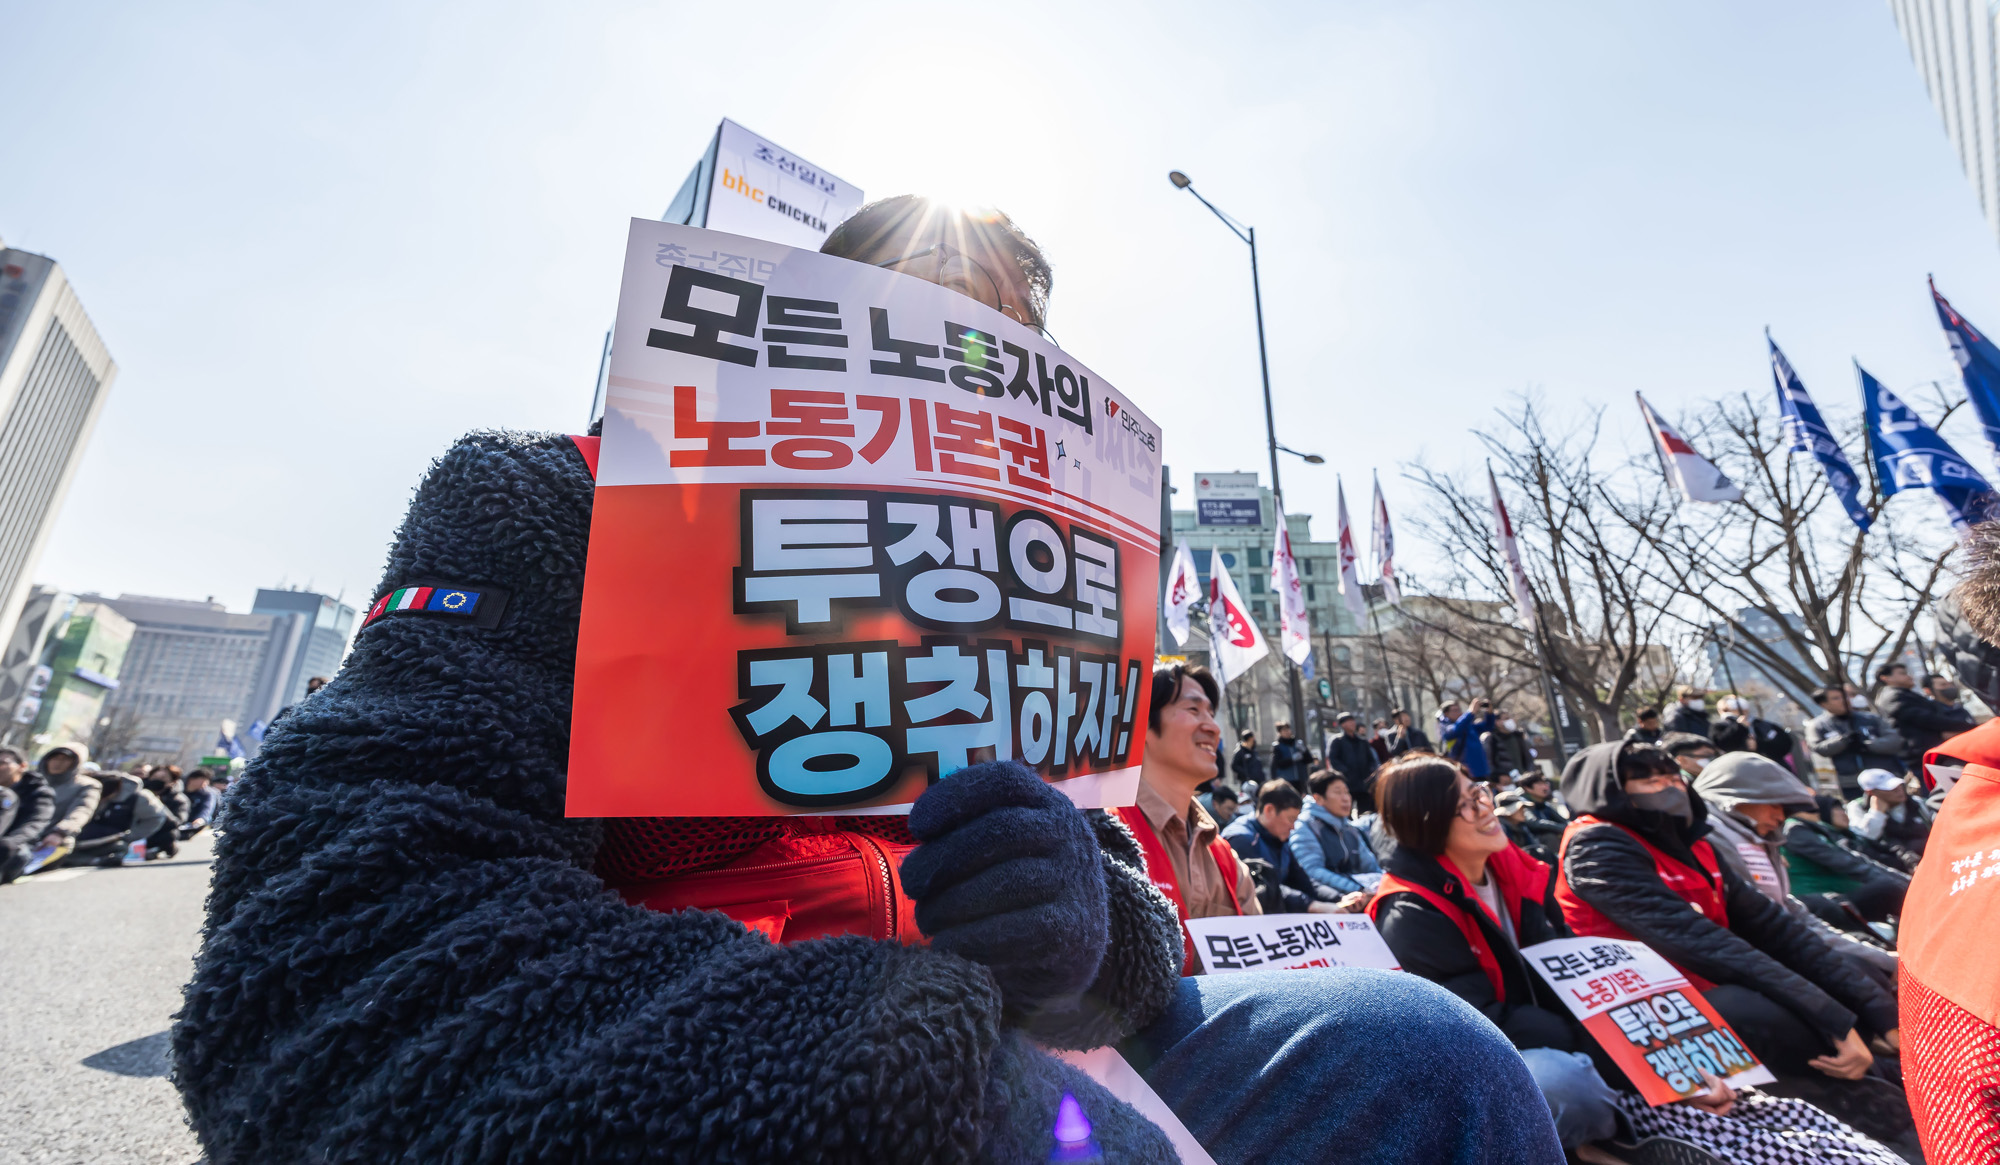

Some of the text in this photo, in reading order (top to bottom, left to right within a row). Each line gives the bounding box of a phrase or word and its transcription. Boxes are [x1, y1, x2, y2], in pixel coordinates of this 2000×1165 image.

[753, 143, 837, 197] 조선일보
[722, 168, 828, 233] bhc CHICKEN
[646, 265, 1094, 435] 모든 노동자의
[669, 386, 1053, 495] 노동기본권
[1121, 408, 1156, 453] 민주노총
[742, 497, 1120, 640] 투쟁으로
[743, 644, 1141, 796] 쟁취하자!
[1205, 935, 1263, 969] 모든
[1256, 920, 1341, 961] 노동자의
[1540, 953, 1590, 981] 모든
[1571, 968, 1649, 1010] 노동기본권
[1609, 991, 1709, 1047] 투쟁으로
[1644, 1025, 1753, 1093] 쟁취하자!
